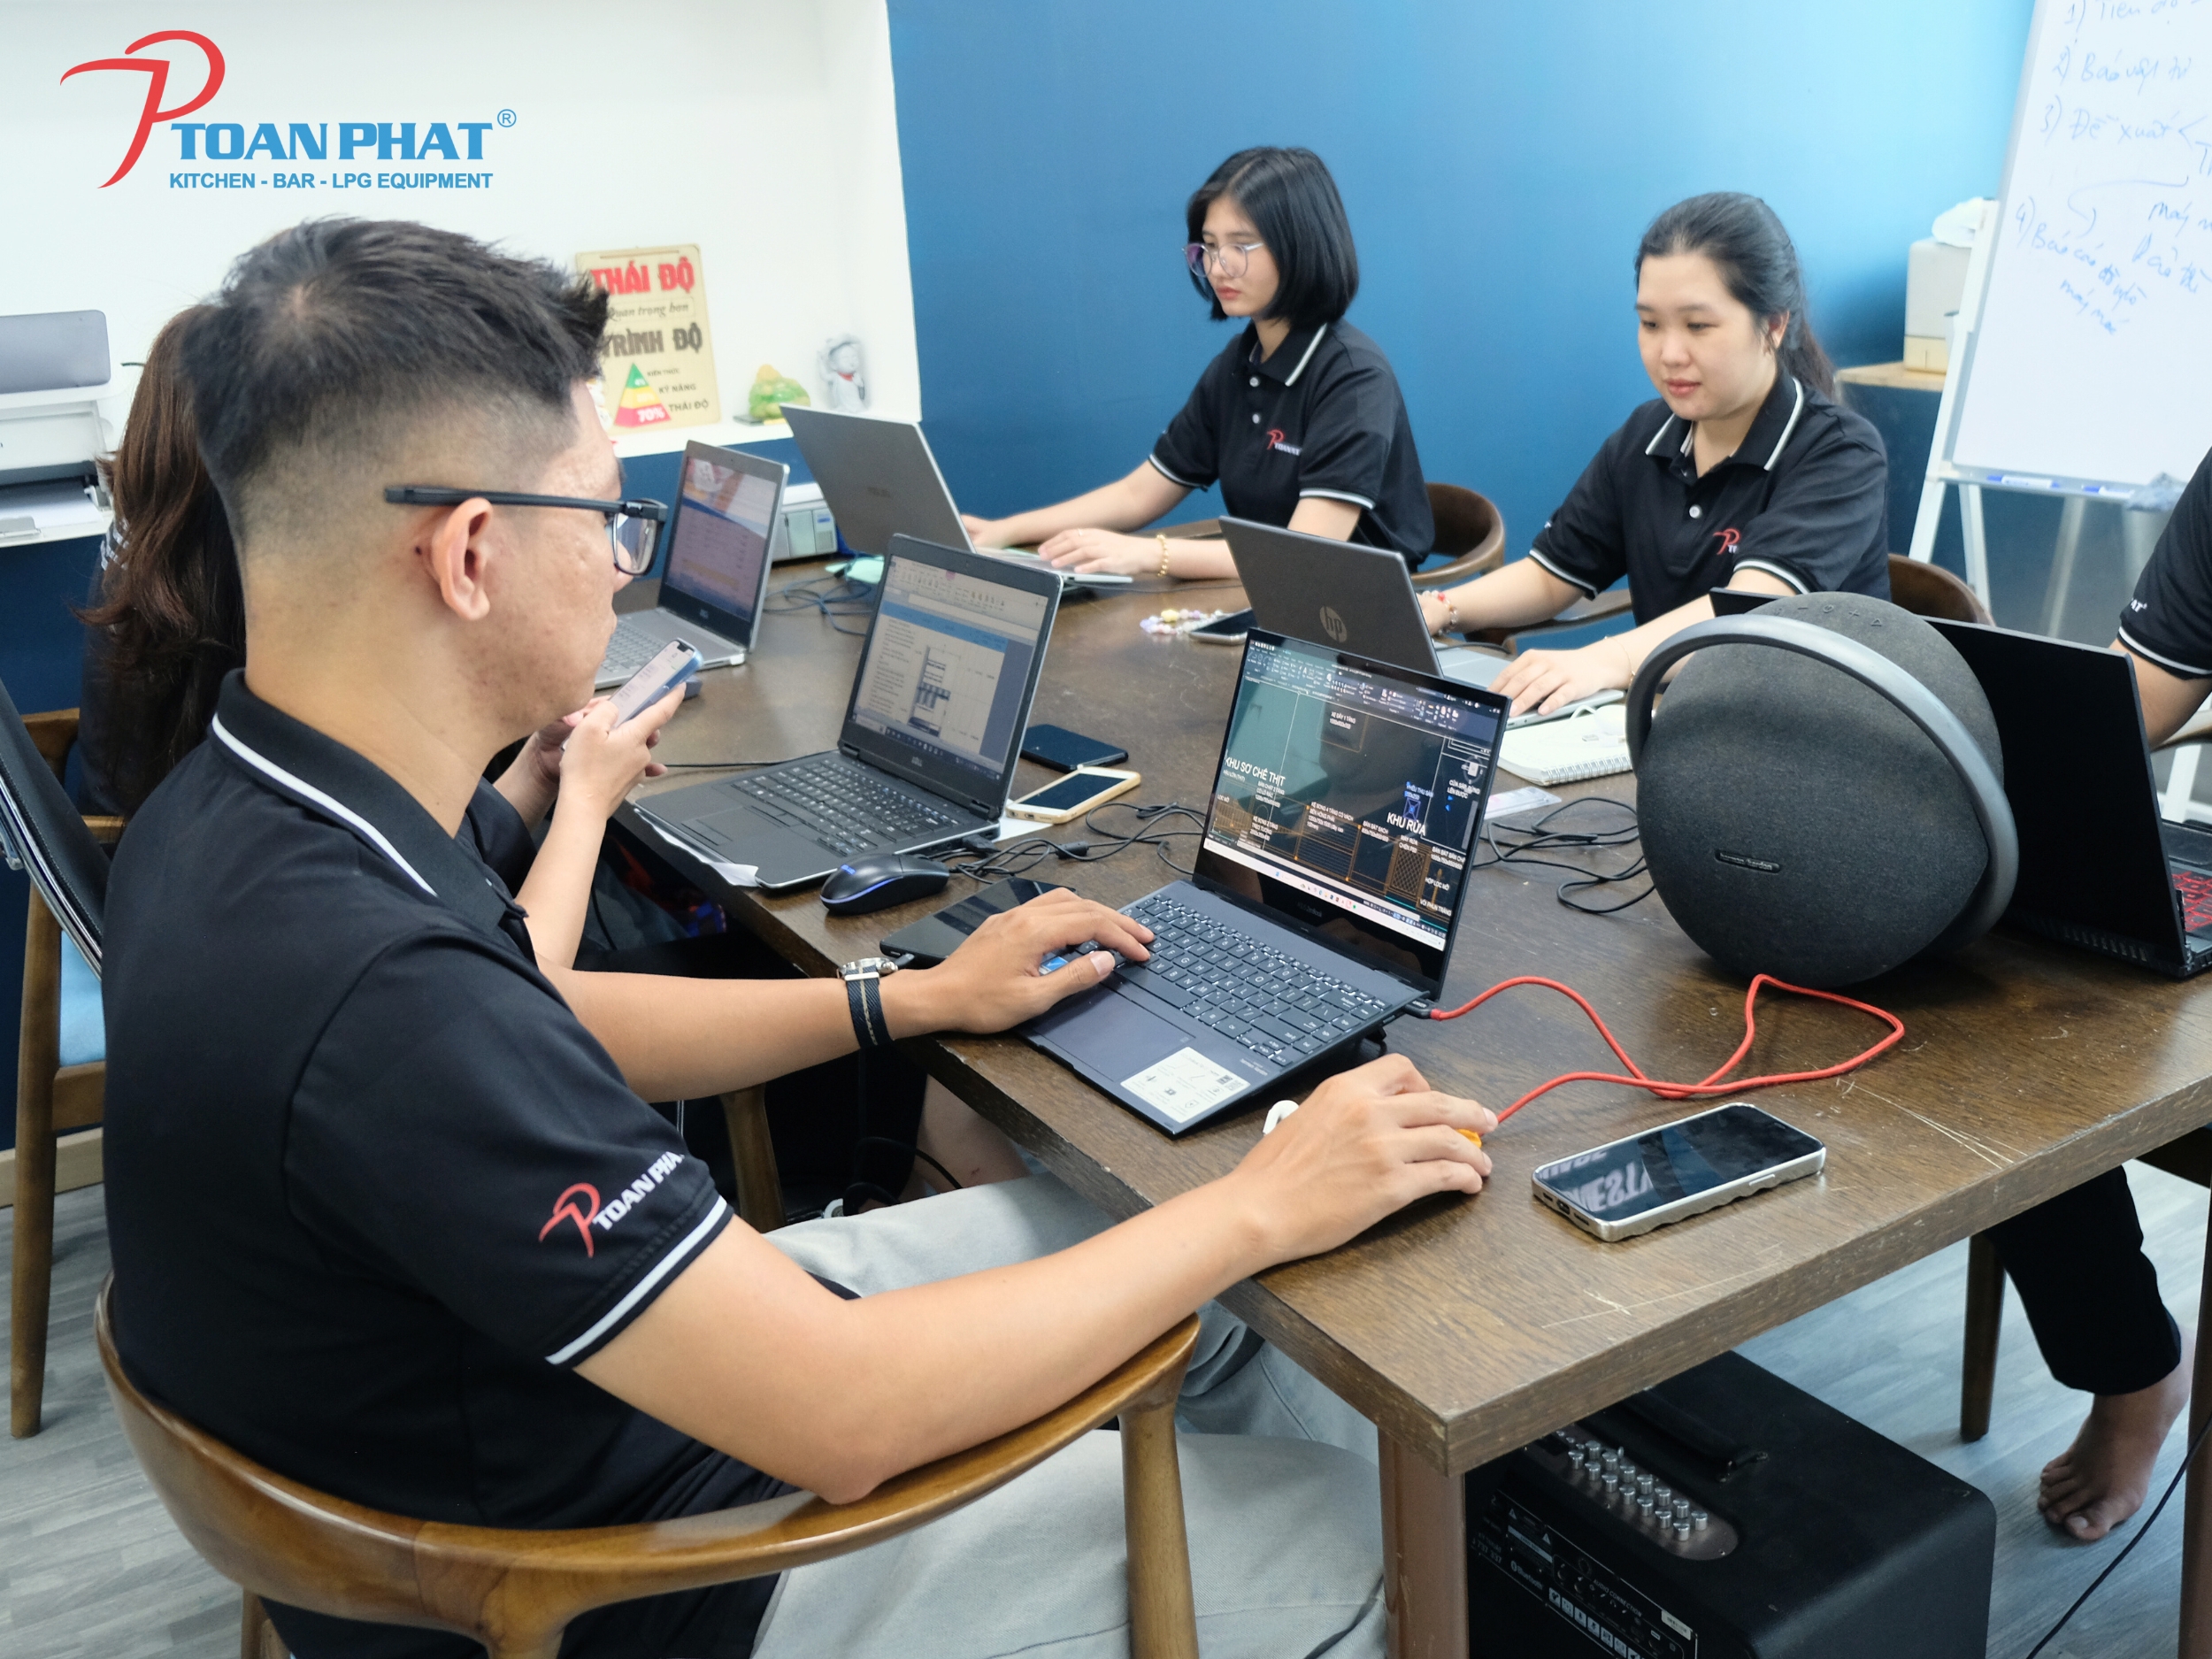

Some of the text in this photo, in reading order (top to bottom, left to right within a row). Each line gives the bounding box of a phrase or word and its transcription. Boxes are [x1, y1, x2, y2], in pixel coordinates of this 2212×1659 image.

[590, 256, 695, 296] THÁI ĐỘ
[672, 322, 703, 354] ĐỘ
[637, 408, 665, 423] 70%
[668, 402, 692, 412] THÁI
[1225, 757, 1240, 770] KHU
[1240, 762, 1253, 774] SƠ
[1269, 771, 1286, 787] THỊT
[1386, 812, 1426, 836] KHU RỬA
[592, 1151, 685, 1231] TOAN PHA
